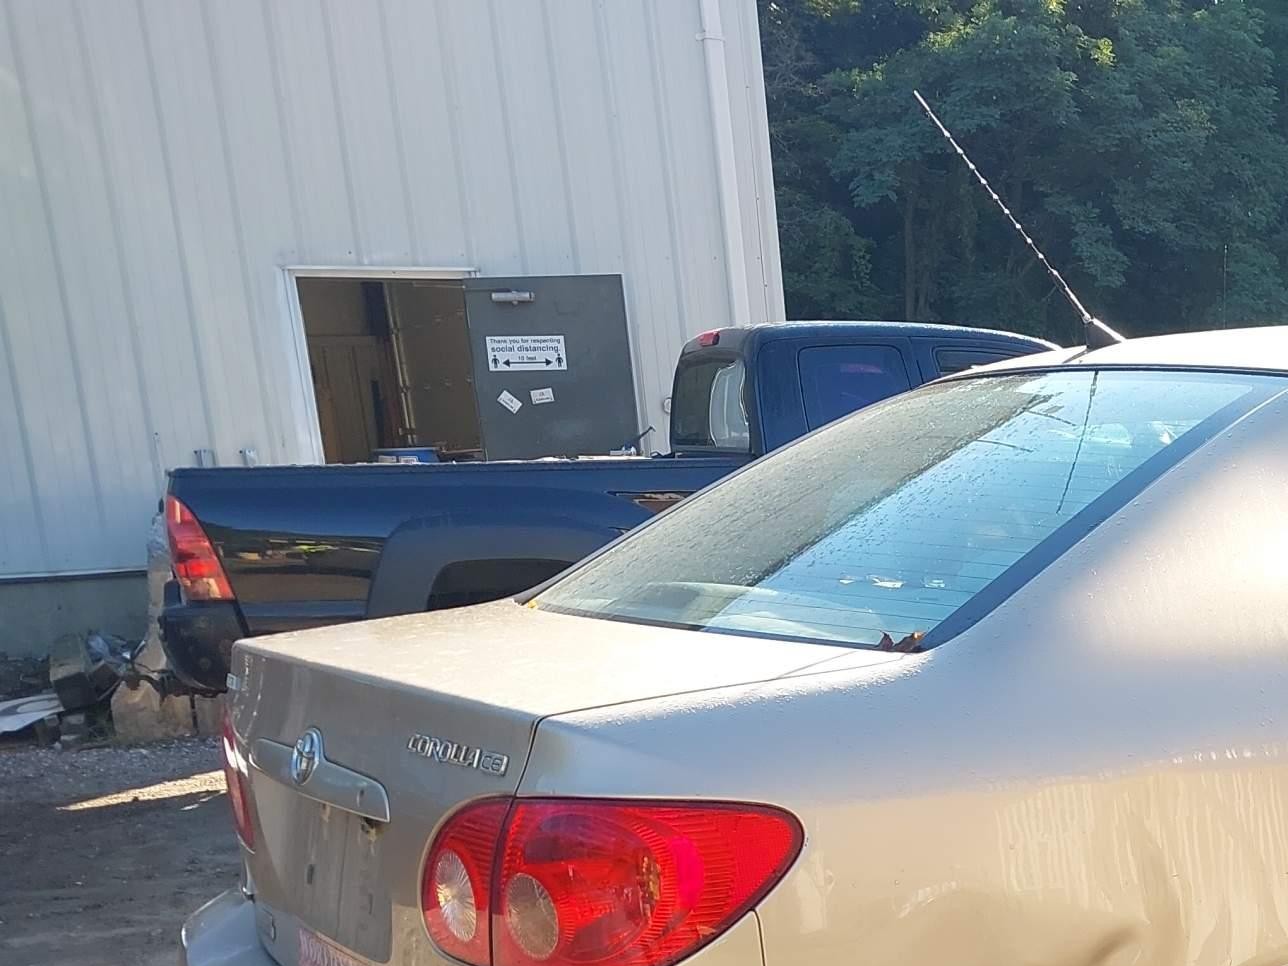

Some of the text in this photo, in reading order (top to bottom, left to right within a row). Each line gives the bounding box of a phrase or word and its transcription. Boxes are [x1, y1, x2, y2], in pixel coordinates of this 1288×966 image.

[491, 344, 561, 353] social distancing.
[407, 733, 481, 769] COROLLA
